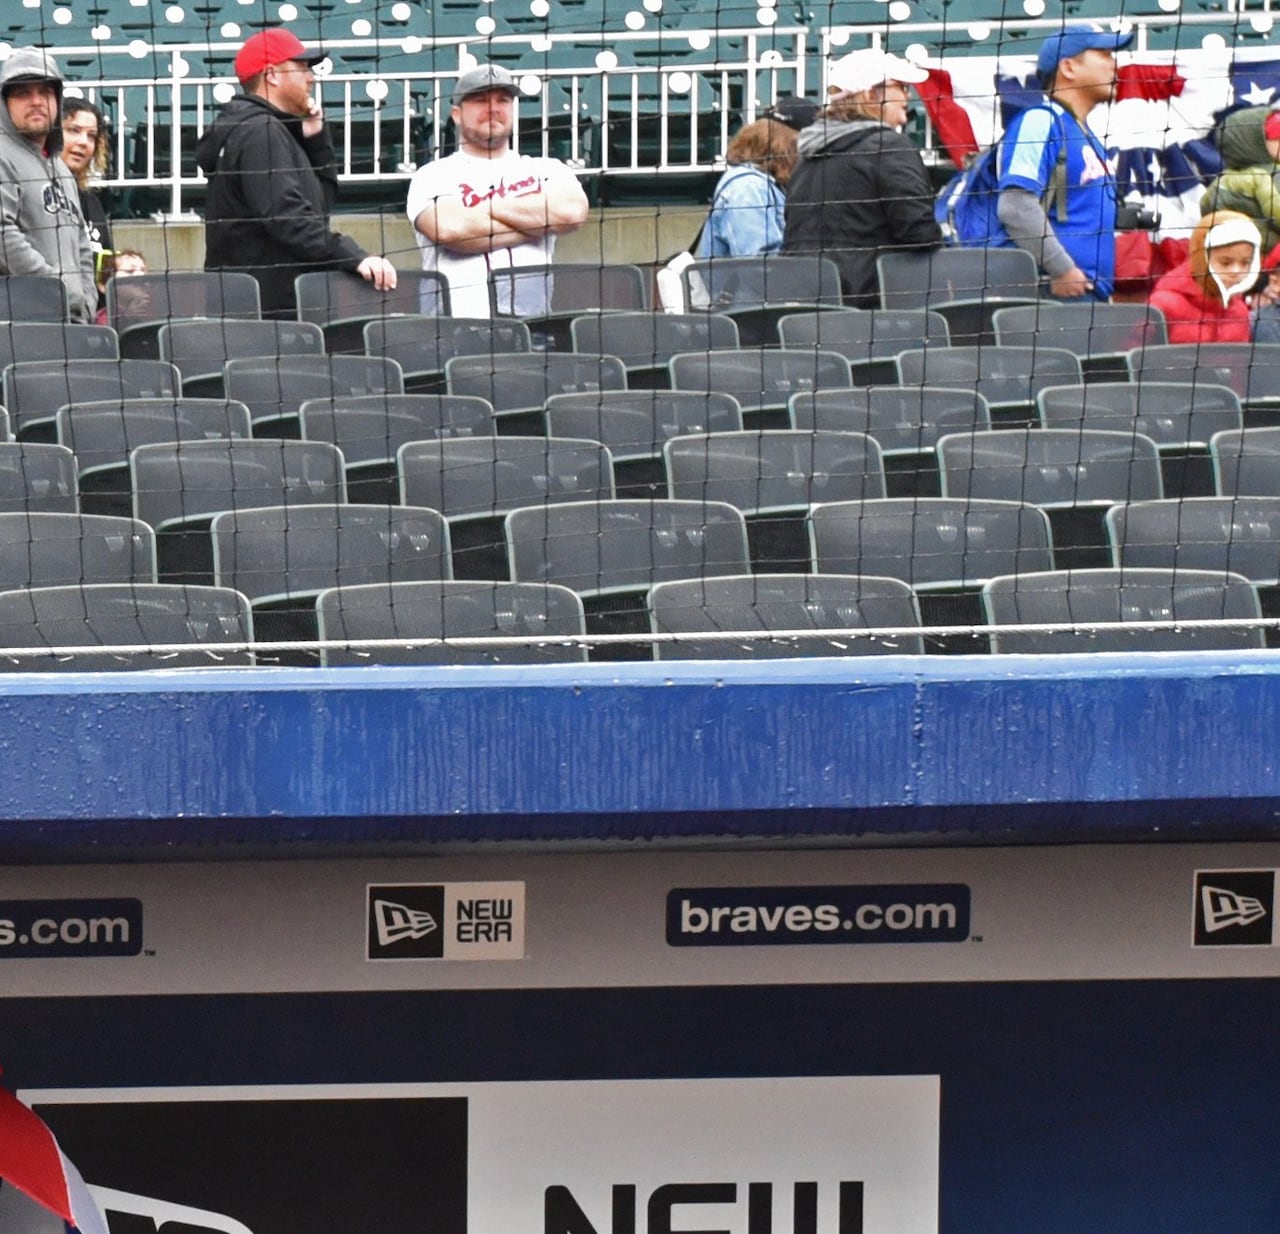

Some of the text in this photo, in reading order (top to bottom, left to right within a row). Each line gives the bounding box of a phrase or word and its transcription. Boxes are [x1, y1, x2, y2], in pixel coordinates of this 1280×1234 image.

[456, 899, 513, 920] NEW
[681, 900, 956, 933] braves.com
[456, 923, 513, 943] ERA
